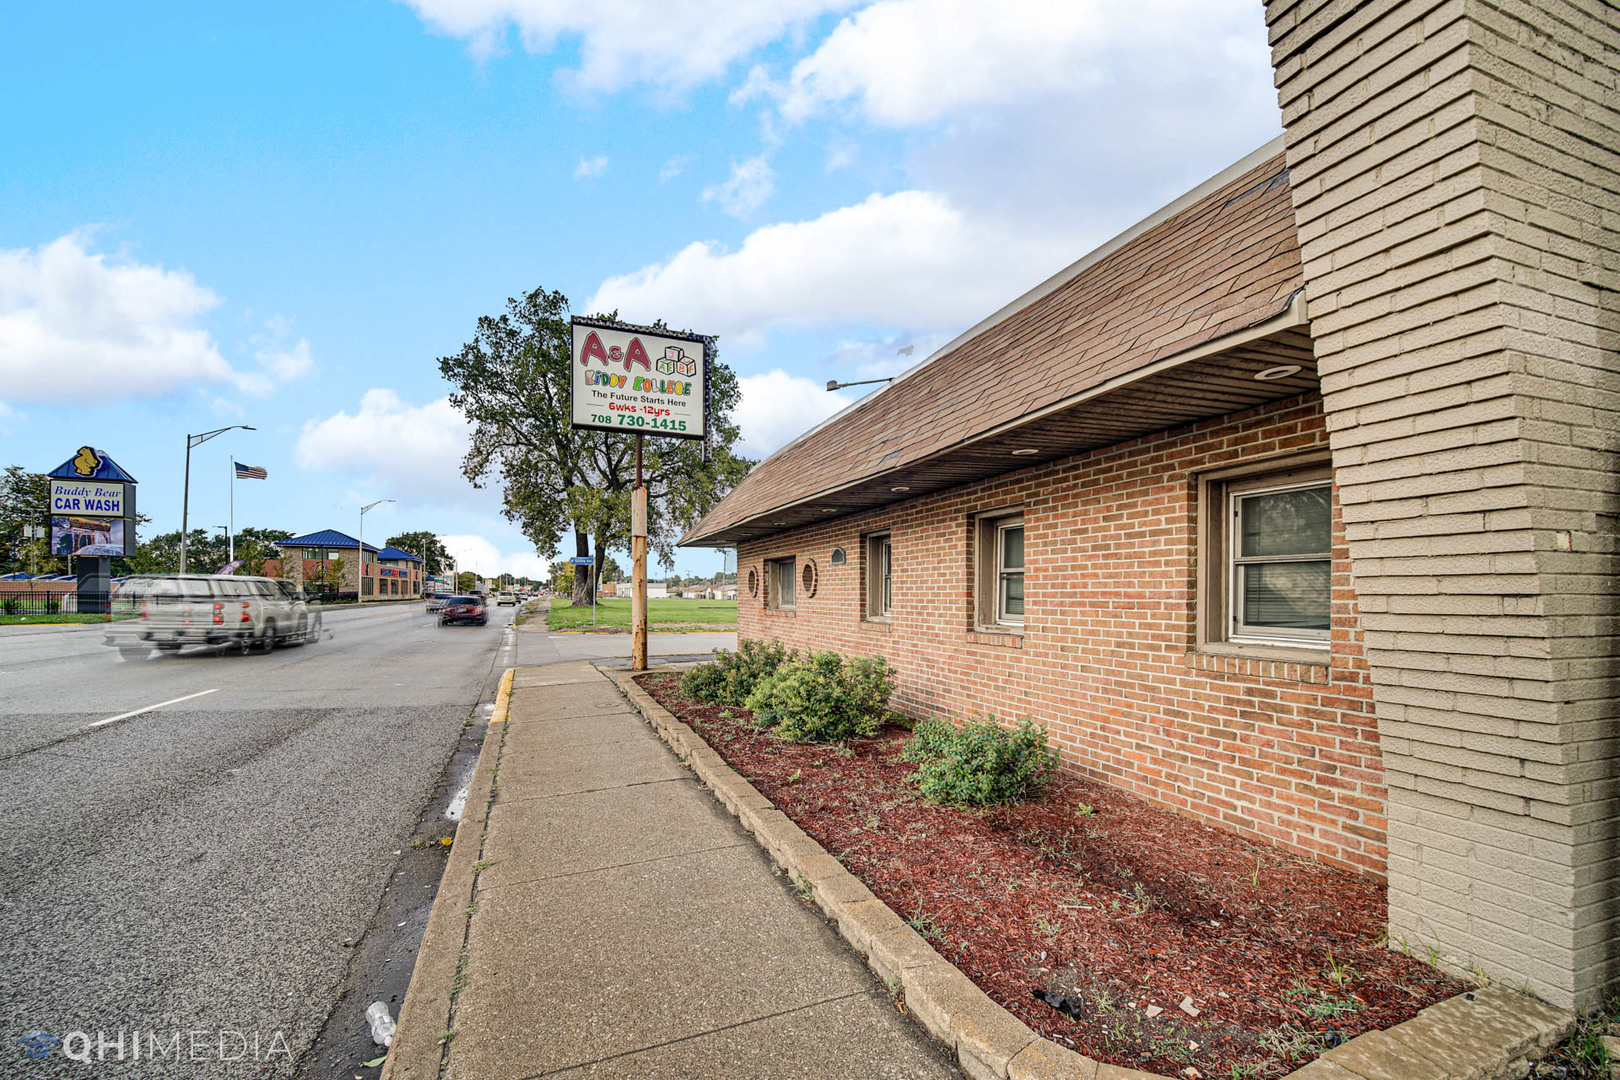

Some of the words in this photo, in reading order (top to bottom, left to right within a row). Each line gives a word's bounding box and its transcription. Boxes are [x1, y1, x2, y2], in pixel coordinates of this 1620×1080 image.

[580, 331, 652, 372] A&A
[633, 376, 692, 396] KOLLEGE
[592, 390, 608, 399] The
[610, 393, 638, 403] Future
[640, 396, 665, 405] Starts
[667, 399, 686, 407] Here
[608, 402, 637, 413] 6wks
[591, 414, 612, 424] 708
[617, 414, 687, 431] 730-1415
[54, 486, 91, 498] Buddy
[94, 488, 122, 497] Bear
[54, 497, 81, 510] CAR
[84, 499, 120, 512] WASH
